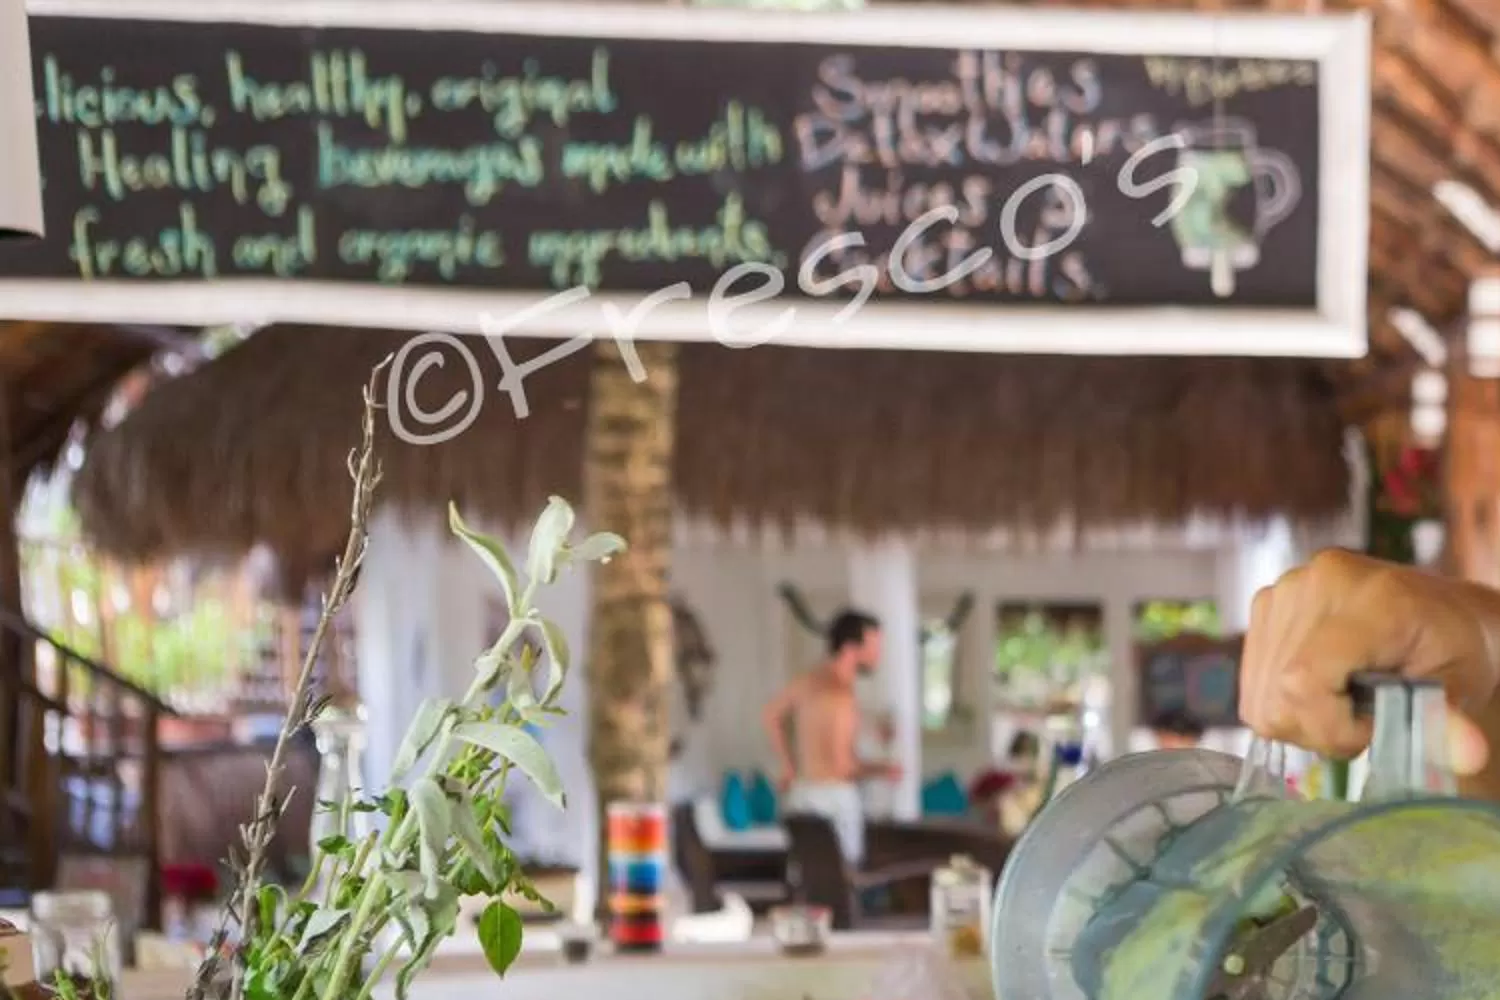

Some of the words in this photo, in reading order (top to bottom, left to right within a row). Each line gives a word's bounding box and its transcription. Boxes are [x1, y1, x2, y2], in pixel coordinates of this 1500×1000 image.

[431, 46, 617, 138] original
[77, 126, 292, 216] Healing
[317, 119, 544, 206] beverages
[561, 113, 674, 194] made
[674, 98, 783, 172] with
[812, 160, 992, 227] Juices
[69, 202, 217, 283] fresh
[232, 203, 318, 278] and
[338, 212, 505, 284] organic
